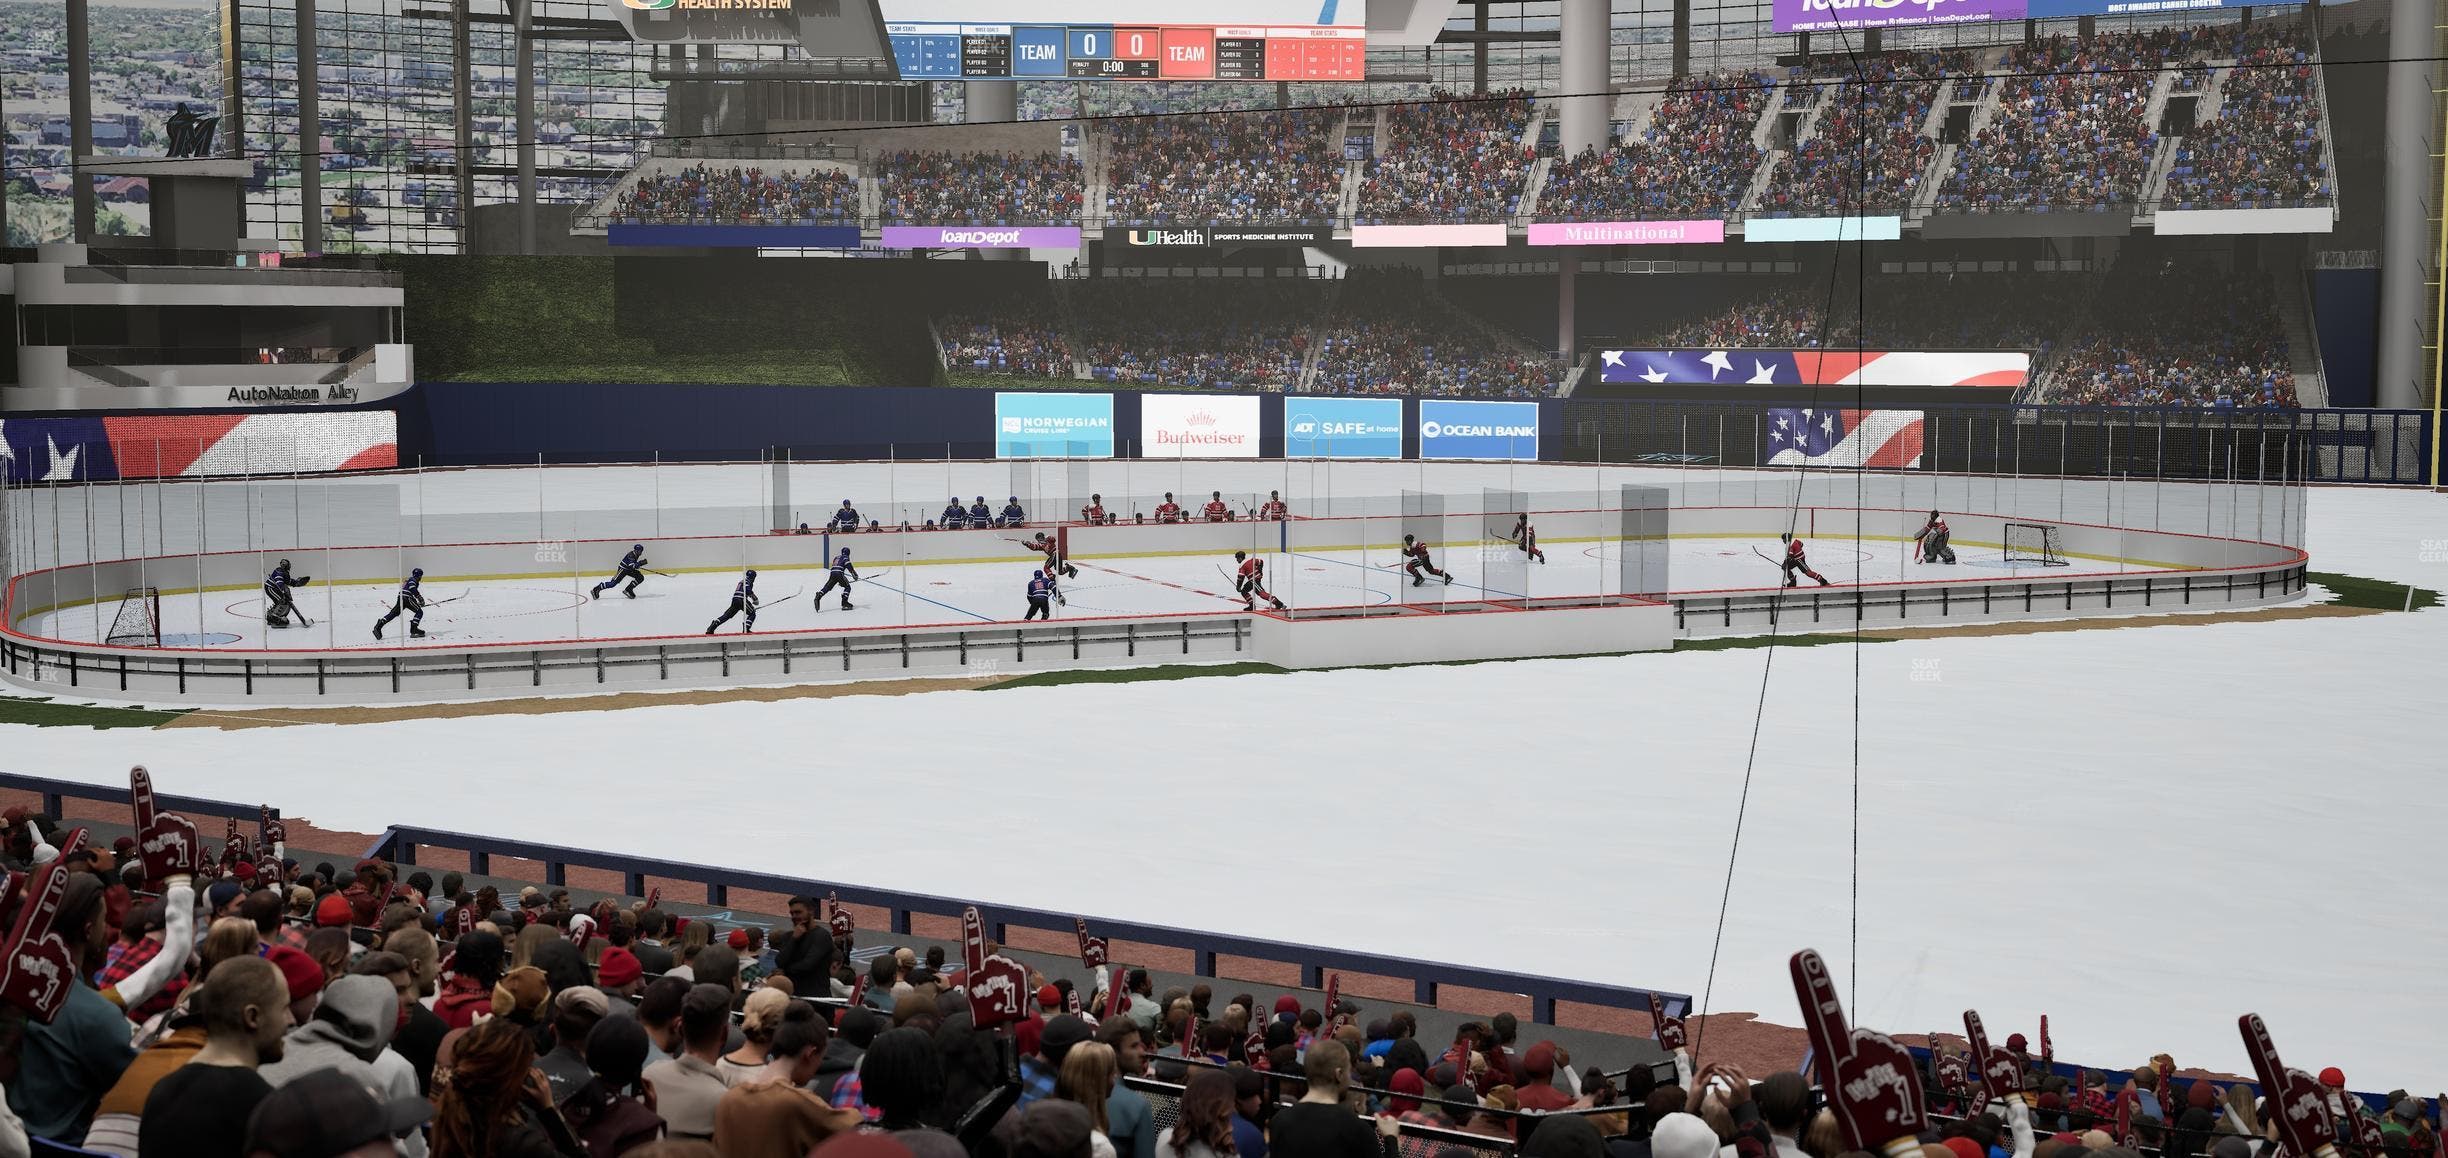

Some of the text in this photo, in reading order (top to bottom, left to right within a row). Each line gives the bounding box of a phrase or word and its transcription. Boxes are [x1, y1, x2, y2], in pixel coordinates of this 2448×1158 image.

[679, 0, 731, 9] HEALTH
[735, 0, 791, 9] SYSTEM
[2108, 4, 2127, 12] MOST
[1084, 33, 1096, 56] 0
[1131, 34, 1143, 56] 0
[1020, 45, 1056, 60] TEAM
[1169, 46, 1205, 61] TEAM
[1103, 61, 1124, 72] 0:00
[941, 230, 1020, 245] loanDepot
[1565, 225, 1685, 241] Multinational
[227, 384, 359, 402] AutoNation Alley
[1024, 418, 1107, 427] NORWEGIAN
[1294, 423, 1315, 433] ADT
[1322, 423, 1366, 434] SAFE
[1377, 425, 1399, 433] home
[1157, 430, 1245, 444] Budweiser
[1443, 425, 1536, 436] OCEAN BANK
